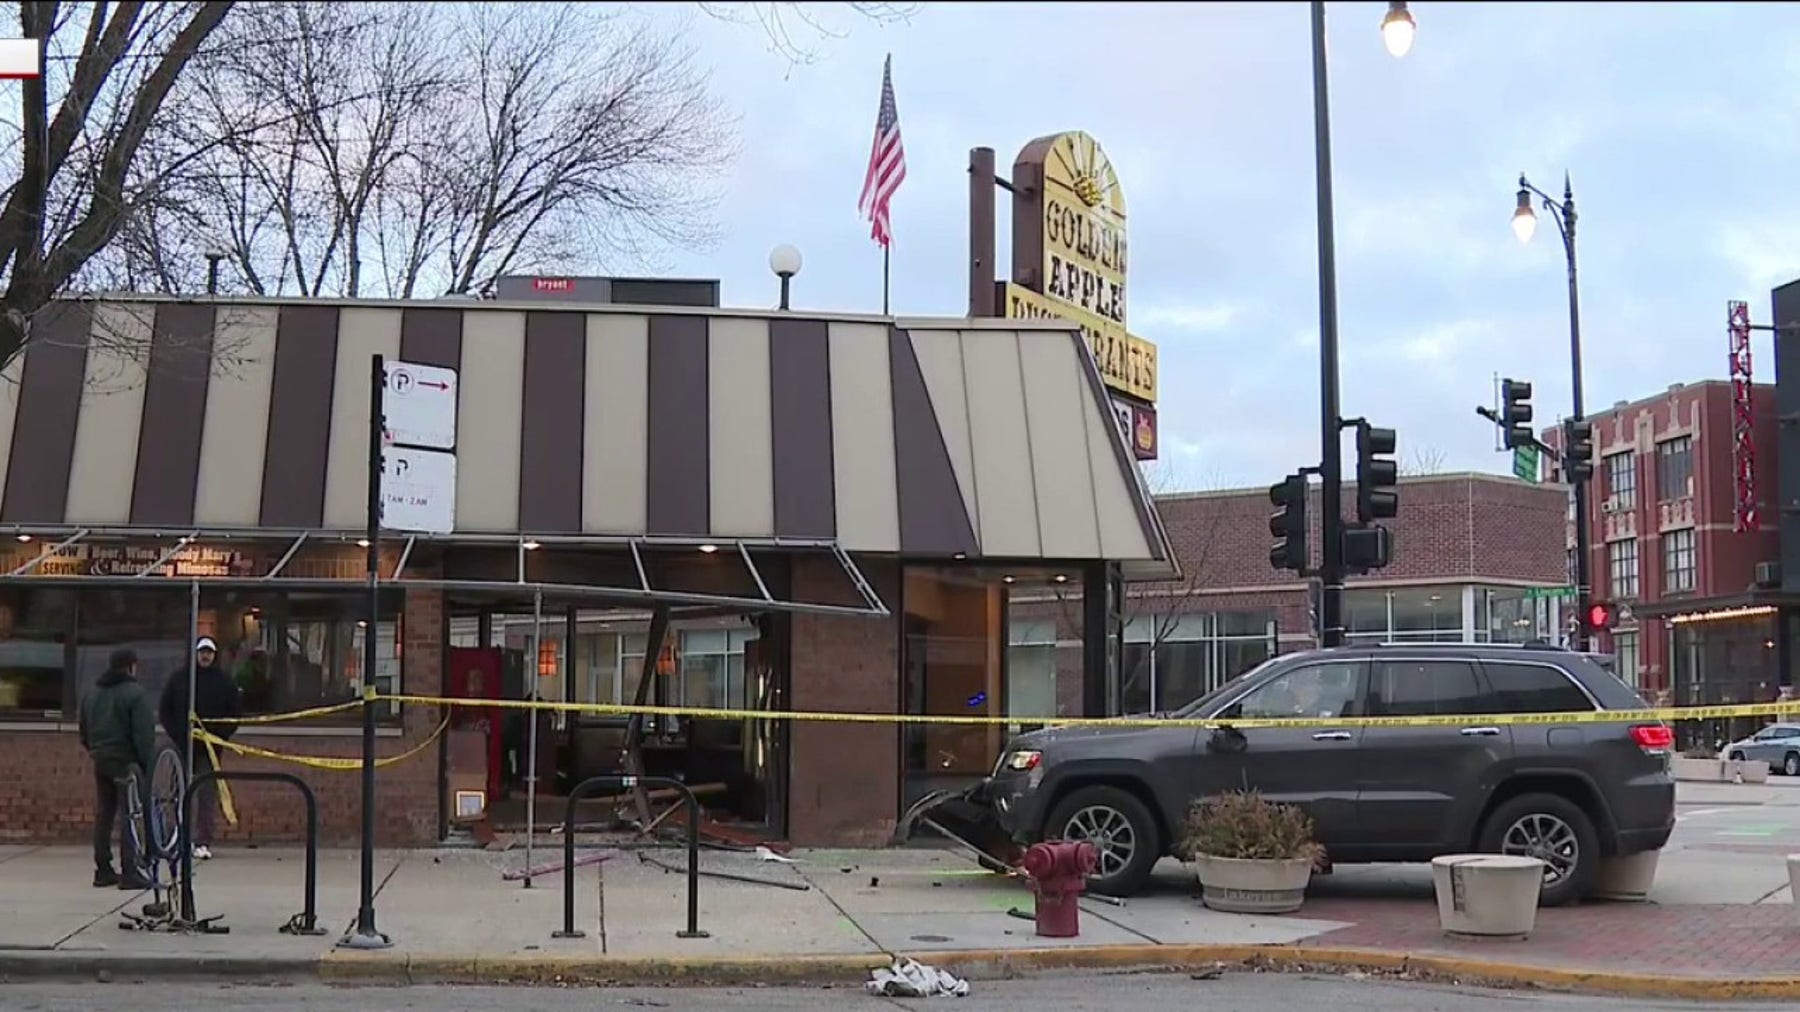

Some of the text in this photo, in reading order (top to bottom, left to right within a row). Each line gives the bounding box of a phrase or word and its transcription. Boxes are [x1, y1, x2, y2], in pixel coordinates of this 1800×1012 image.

[1046, 199, 1127, 274] GOLDEN
[537, 279, 568, 291] bryant
[1048, 255, 1123, 322] APPLE
[177, 561, 228, 575] Mimosas
